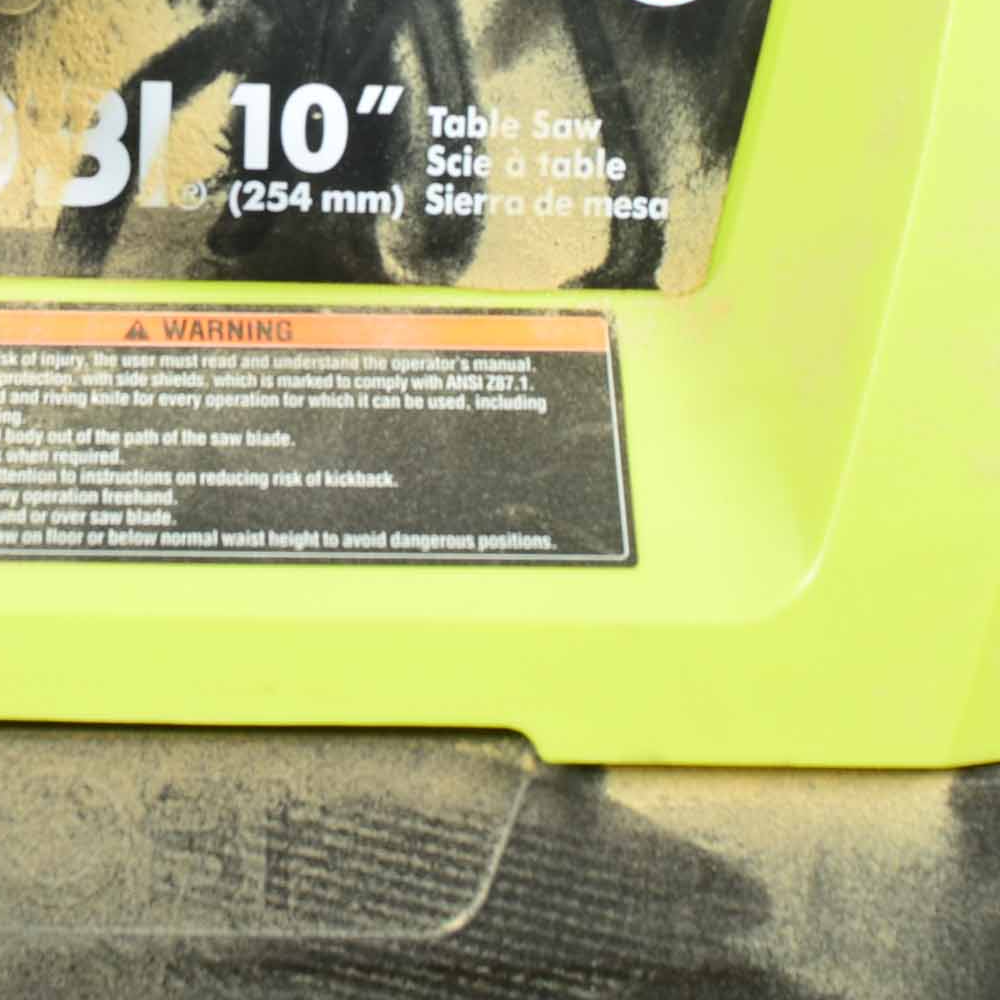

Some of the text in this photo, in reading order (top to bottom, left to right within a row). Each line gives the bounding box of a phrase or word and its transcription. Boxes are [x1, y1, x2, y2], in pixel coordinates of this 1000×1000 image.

[230, 82, 404, 174] 10"
[427, 106, 603, 140] Table Saw
[426, 145, 492, 178] Scie
[537, 147, 627, 181] table
[228, 179, 405, 220] (254 mm)
[425, 187, 669, 220] Sierra de mesa
[163, 318, 294, 343] WARNING
[21, 352, 38, 367] of
[94, 352, 118, 368] the
[121, 354, 156, 369] user
[160, 354, 199, 369] must
[201, 354, 237, 370] read
[241, 355, 269, 370] and
[273, 355, 360, 371] understand
[362, 355, 388, 371] the
[391, 357, 470, 374] operator's
[472, 357, 537, 373] manual.
[486, 375, 535, 392] Z87.1.
[8, 390, 39, 405] and
[43, 391, 88, 408] riving
[91, 390, 131, 406] knife
[133, 390, 154, 407] for
[158, 392, 201, 410] every
[204, 392, 280, 411] operation
[283, 392, 304, 408] for
[308, 392, 354, 409] which
[357, 393, 369, 409] it
[372, 394, 401, 409] can
[404, 394, 424, 410] be
[427, 395, 471, 412] used,
[475, 395, 547, 414] including
[5, 428, 44, 446] body
[46, 430, 72, 445] out
[75, 429, 92, 445] of
[94, 430, 120, 446] the
[123, 430, 159, 448] path
[161, 430, 179, 446] of
[181, 430, 208, 447] the
[210, 432, 243, 447] saw
[245, 430, 296, 447] blade.
[20, 530, 43, 546] on
[46, 528, 84, 546] floor
[86, 531, 105, 546] or
[108, 528, 158, 547] below
[160, 530, 218, 548] normal
[220, 530, 266, 548] waist
[268, 530, 320, 551] height
[322, 531, 340, 548] to
[342, 531, 388, 549] avoid
[390, 532, 476, 552] dangerous
[478, 532, 558, 552] positions.
